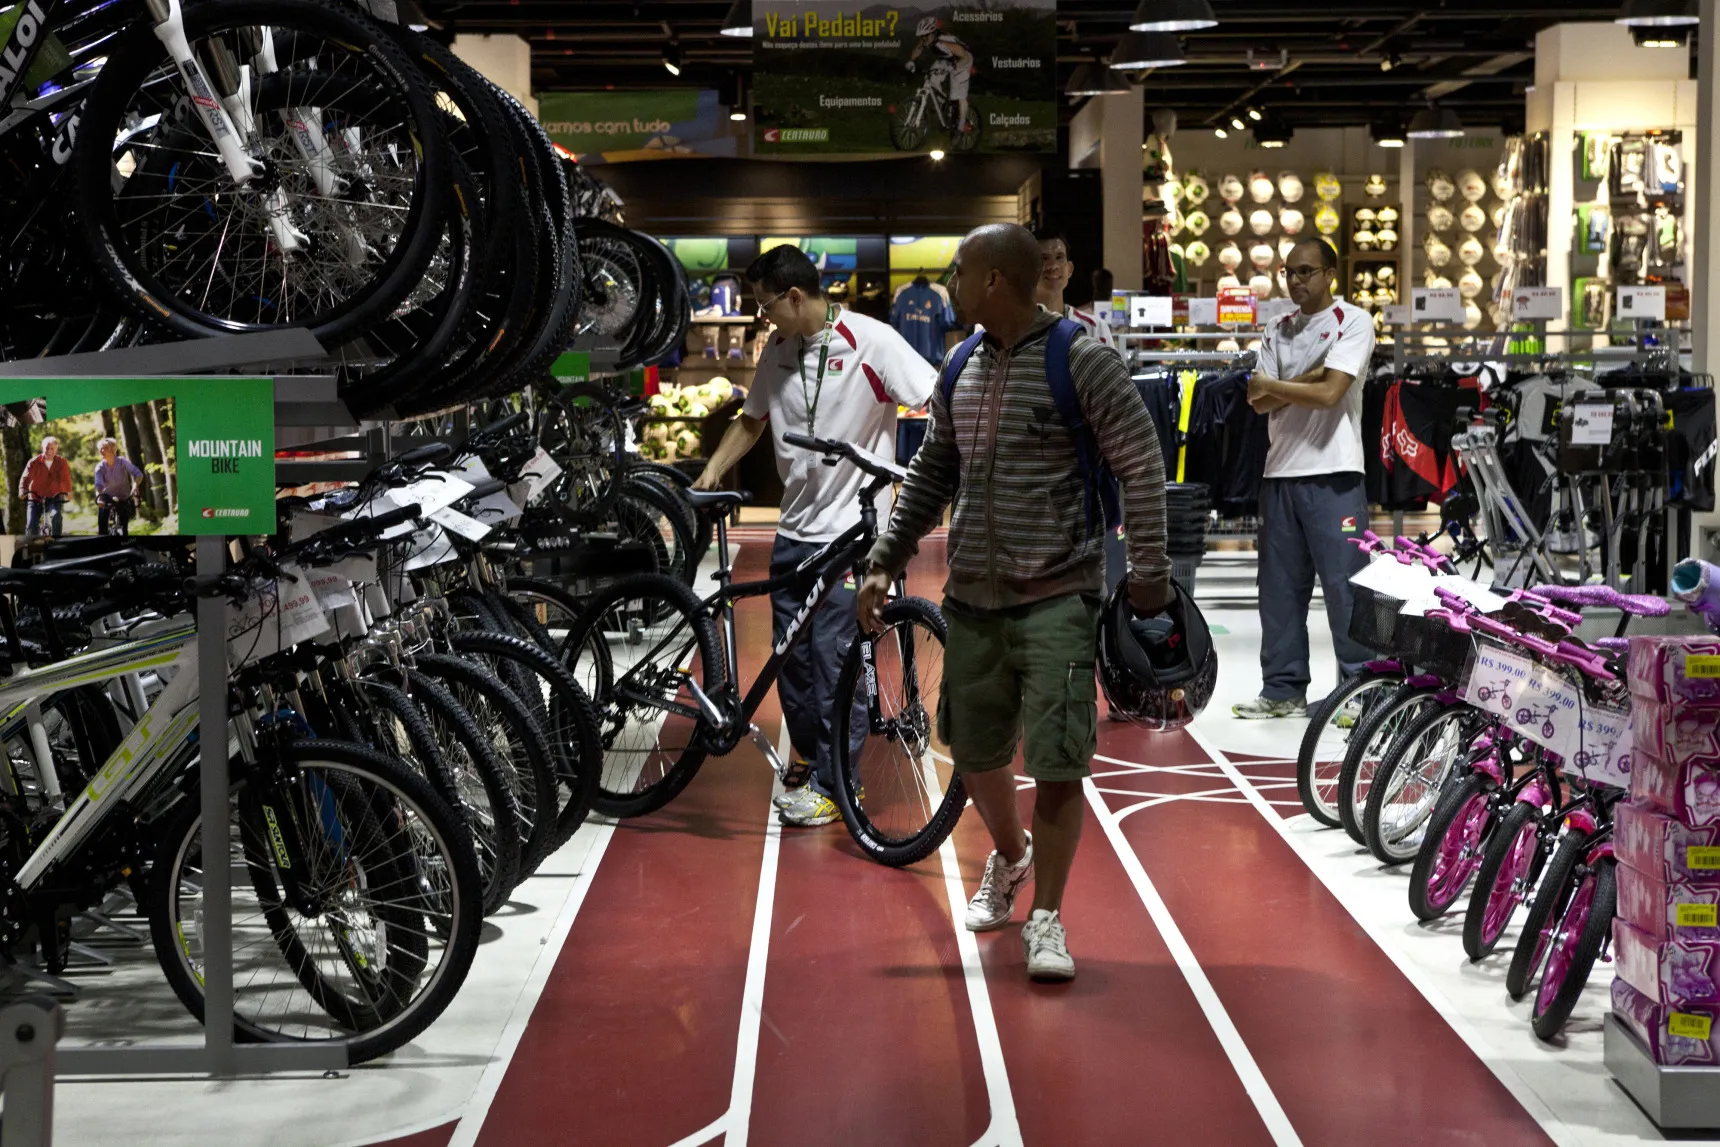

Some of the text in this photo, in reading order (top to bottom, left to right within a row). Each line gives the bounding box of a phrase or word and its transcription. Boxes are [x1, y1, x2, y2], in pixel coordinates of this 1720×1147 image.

[765, 10, 899, 37] Vai Pedalar?
[953, 10, 1004, 22] Acessórios
[992, 56, 1041, 69] Vestuários
[819, 94, 882, 107] Equipamentos
[594, 121, 631, 134] com
[633, 117, 671, 133] tudo
[989, 112, 1031, 127] Calçados
[781, 129, 827, 141] CENTAURO
[188, 440, 262, 457] MOUNTAIN
[211, 458, 240, 474] BIKE
[215, 509, 250, 517] CENTAURO
[775, 575, 826, 656] CALOI
[1480, 656, 1495, 668] R$
[1496, 661, 1527, 679] 399.00
[1528, 678, 1543, 691] R$
[1543, 687, 1576, 710] 399.00
